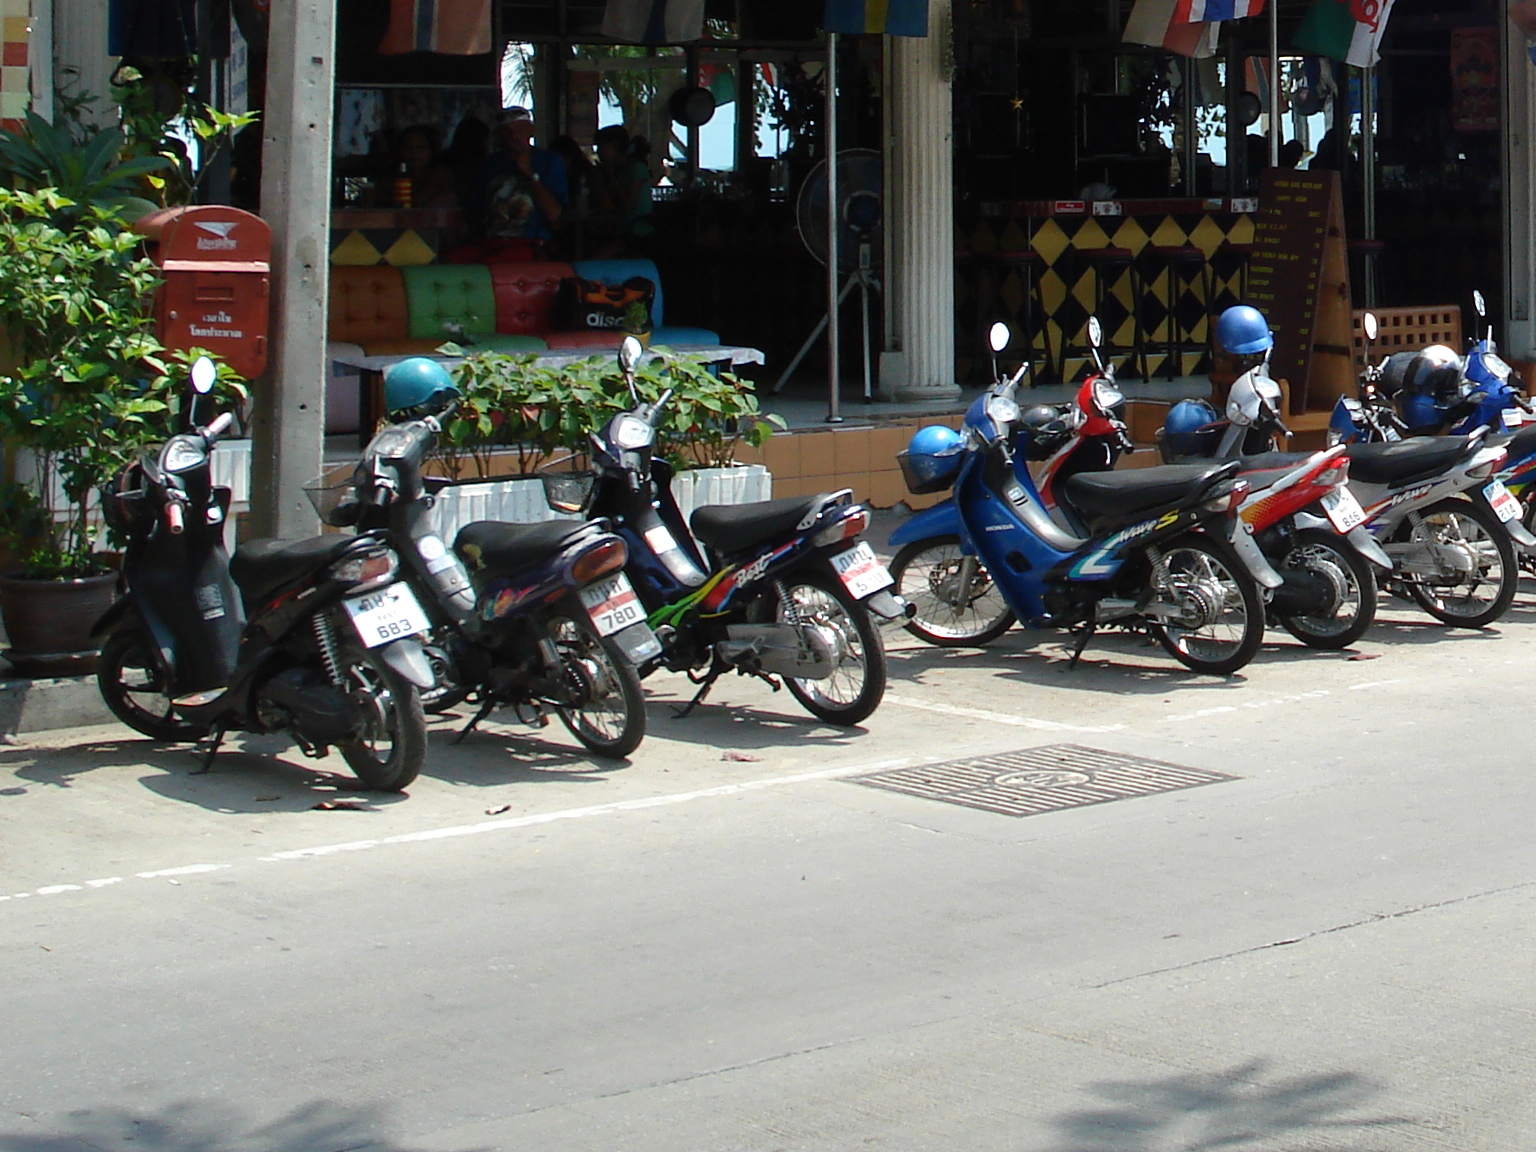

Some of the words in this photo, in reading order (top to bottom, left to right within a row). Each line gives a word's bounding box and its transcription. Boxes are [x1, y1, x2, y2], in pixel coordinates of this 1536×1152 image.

[1119, 519, 1157, 543] Wave
[1155, 509, 1180, 531] S
[602, 606, 637, 628] 780
[377, 619, 412, 639] 683
